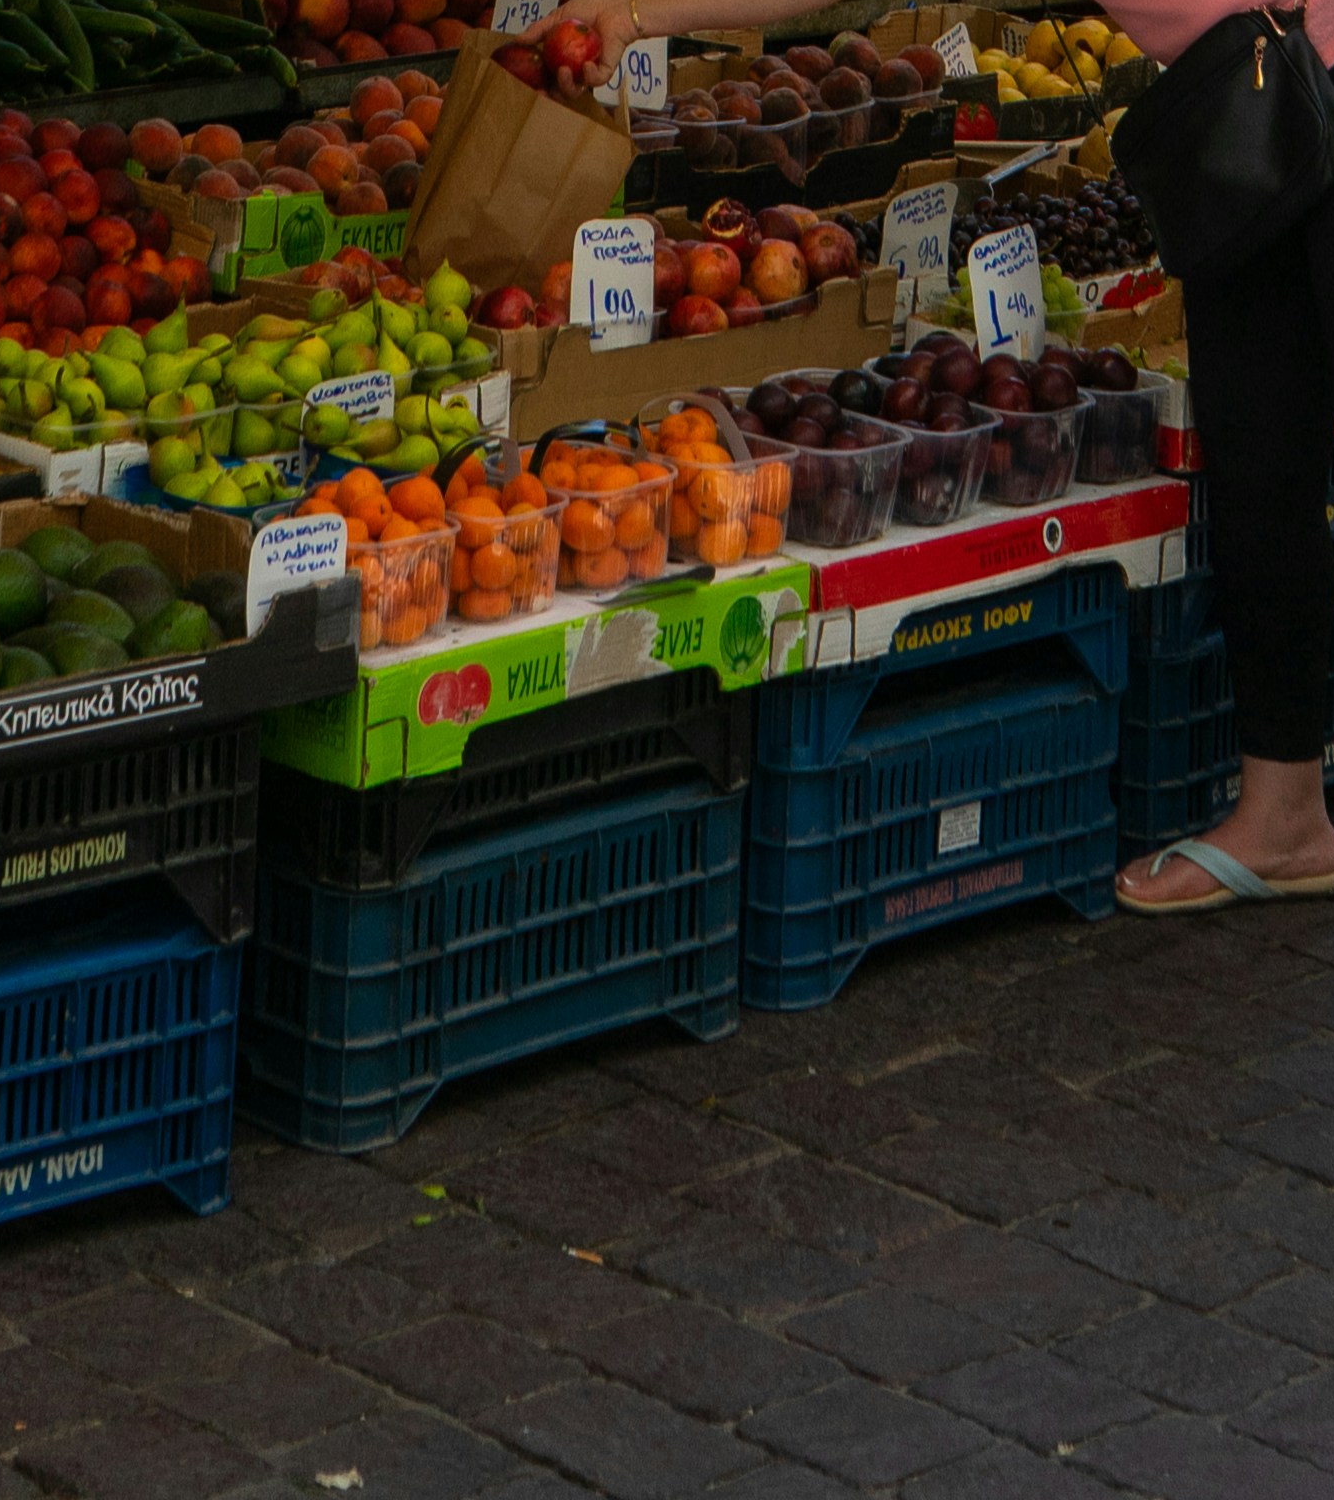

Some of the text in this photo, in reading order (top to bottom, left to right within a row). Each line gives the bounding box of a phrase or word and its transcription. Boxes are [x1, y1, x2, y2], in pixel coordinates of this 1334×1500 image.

[581, 226, 634, 246] ΡΟΔΙΑ
[893, 600, 1033, 653] ΑΦΟΙ ΣΚΟΥΡΑ
[122, 674, 199, 715] Κρήτης
[508, 651, 566, 701] ΥΤΙΚΑ
[1, 831, 126, 888] KOKOLIOS FRUIT
[40, 1143, 103, 1185] ΙΩΑΝ.
